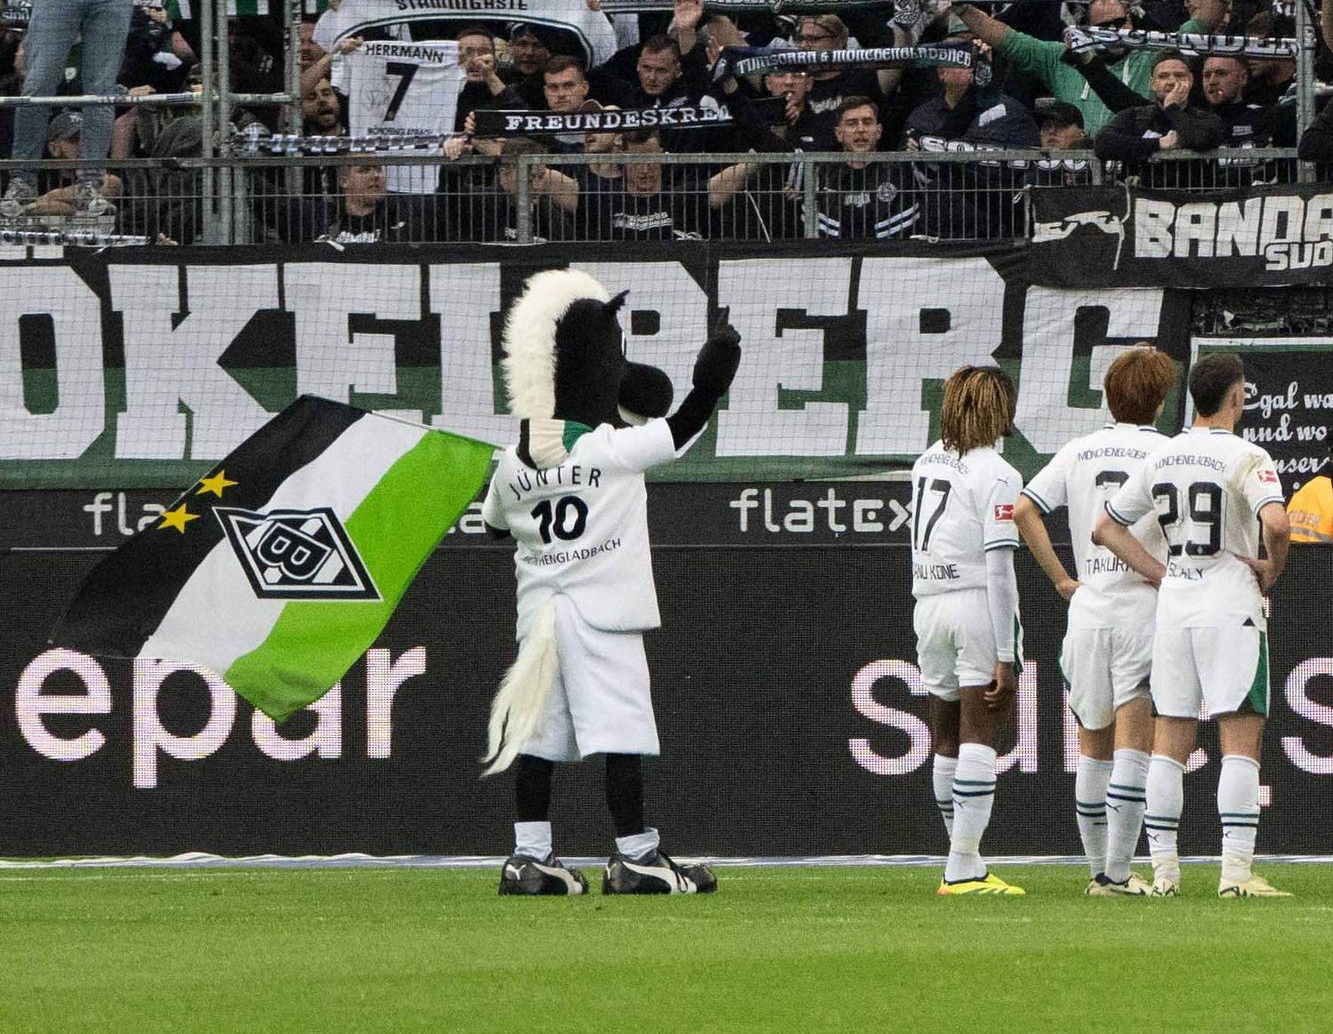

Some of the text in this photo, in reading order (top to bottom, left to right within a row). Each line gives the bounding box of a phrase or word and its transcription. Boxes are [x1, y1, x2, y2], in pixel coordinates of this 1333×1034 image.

[366, 45, 443, 62] HERRMANN
[384, 63, 419, 121] 7
[1242, 383, 1298, 413] Egal
[1243, 422, 1327, 444] und wo
[508, 466, 602, 500] JÜNTER
[530, 495, 587, 544] 10
[914, 476, 951, 553] 17
[1152, 483, 1221, 557] 29
